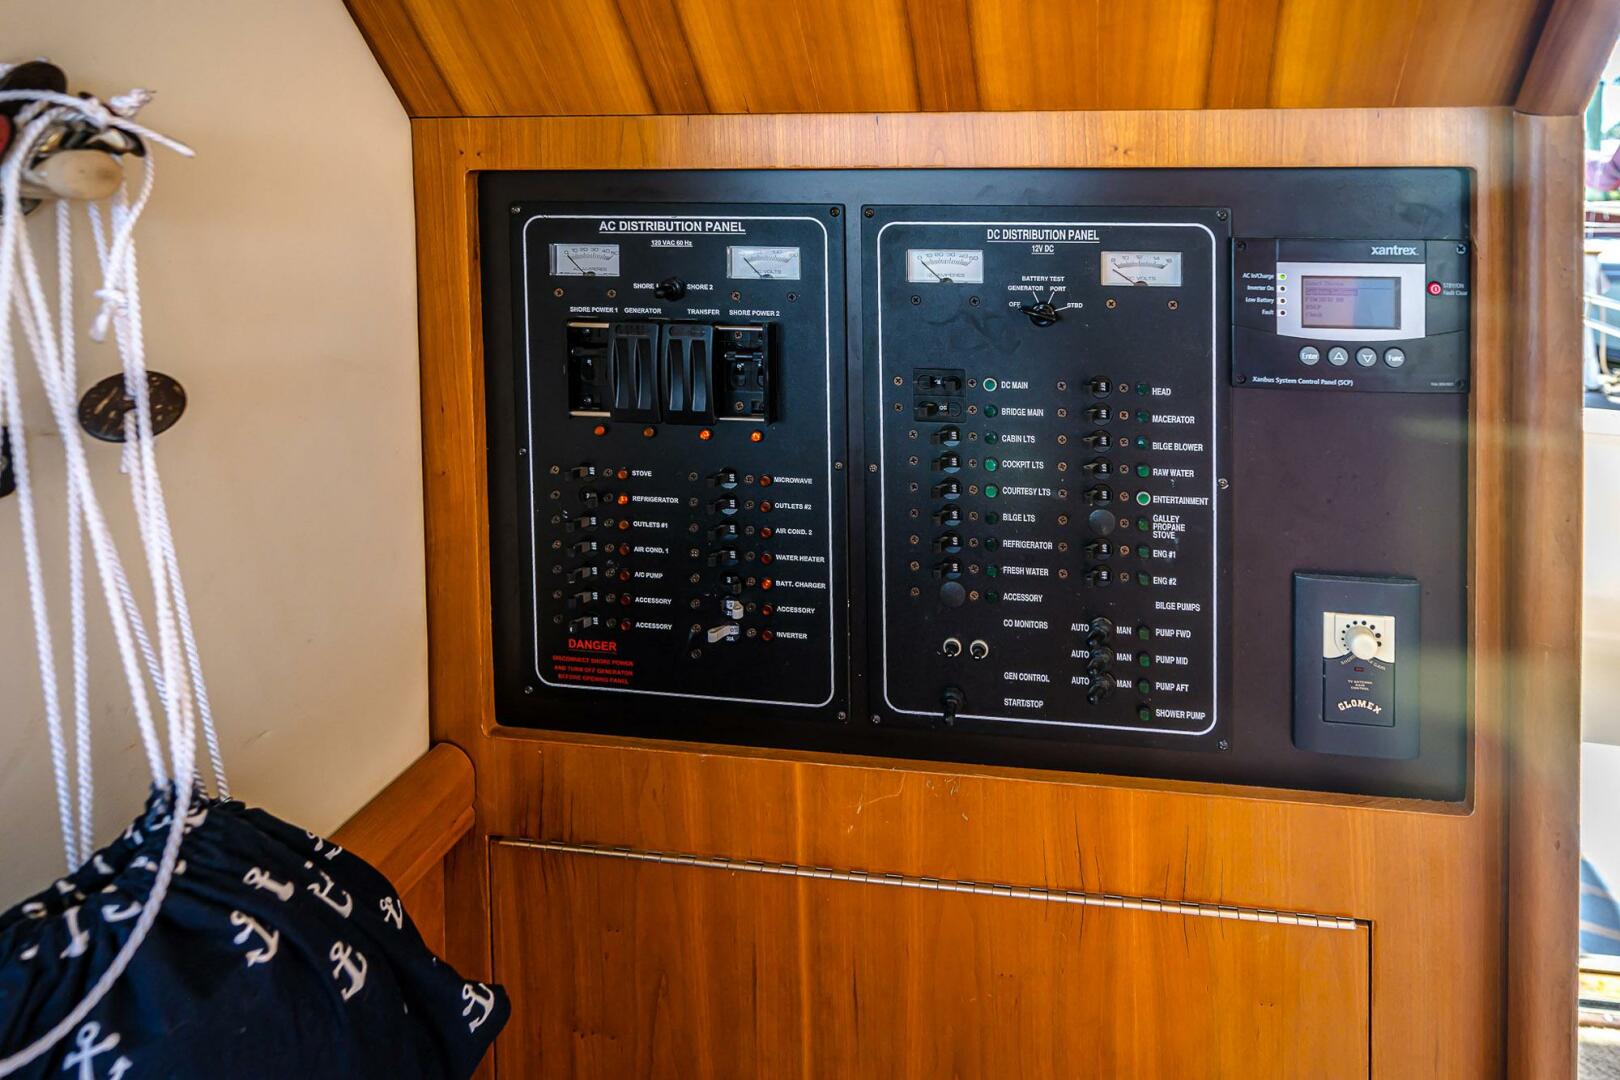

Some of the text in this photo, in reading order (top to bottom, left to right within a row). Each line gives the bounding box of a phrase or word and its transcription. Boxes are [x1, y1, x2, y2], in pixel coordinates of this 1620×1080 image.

[599, 221, 745, 233] AC DISTRIBUTION PANEL
[987, 229, 1099, 241] DC DISTRIBUTION PANEL
[1371, 245, 1417, 255] xantrex
[1301, 352, 1318, 360] Enter
[1275, 376, 1296, 385] System
[1338, 379, 1353, 387] (SCP)
[1152, 388, 1171, 396] HEAD
[1002, 408, 1044, 417] BRIDGE MAIN
[1152, 415, 1195, 424] MACERATOR
[1002, 435, 1036, 443] CABIN LTS
[1152, 442, 1203, 451] BILGE BLOWER
[1002, 460, 1044, 469] COCKPIT LTS
[1152, 468, 1194, 477] RAW WATER
[1002, 486, 1051, 497] COURTESY LTS
[632, 496, 679, 504] REFRIGERATOR
[1153, 496, 1208, 506] ENTERTAINMENT
[1002, 514, 1036, 522] BILGE LTS
[1153, 514, 1180, 523] GALLEY
[1153, 523, 1186, 532] PROPANE
[1152, 531, 1175, 539] STOVE
[1003, 540, 1053, 550] REFRIGERATOR
[1153, 550, 1176, 559] ENG #1
[1003, 566, 1049, 576] FRESH WATER
[1153, 577, 1177, 586] ENG #2
[635, 597, 672, 605] ACCESSORY
[1003, 593, 1043, 603] ACCESSORY
[777, 606, 815, 614] ACCESSORY
[1156, 602, 1200, 612] BILGE PUMPS
[635, 622, 672, 630] ACCESSORY
[1003, 619, 1048, 629] CO MONITORS
[1071, 623, 1089, 632] AUTO
[1116, 626, 1132, 635] MAN
[1156, 628, 1191, 638] PUMP FWD
[568, 639, 616, 651] DANGER
[1071, 650, 1089, 658] AUTO
[1116, 653, 1132, 662] MAN
[1156, 655, 1188, 665] PUMP MID
[1004, 672, 1050, 682] GEN CONTROL
[1071, 676, 1090, 685] AUTO
[1116, 680, 1132, 688] MAN
[1156, 682, 1189, 692] PUMP AFT
[1004, 698, 1043, 708] START/STOP
[1338, 699, 1382, 714] GLOMEX
[1156, 709, 1206, 720] SHOWER PUMP
